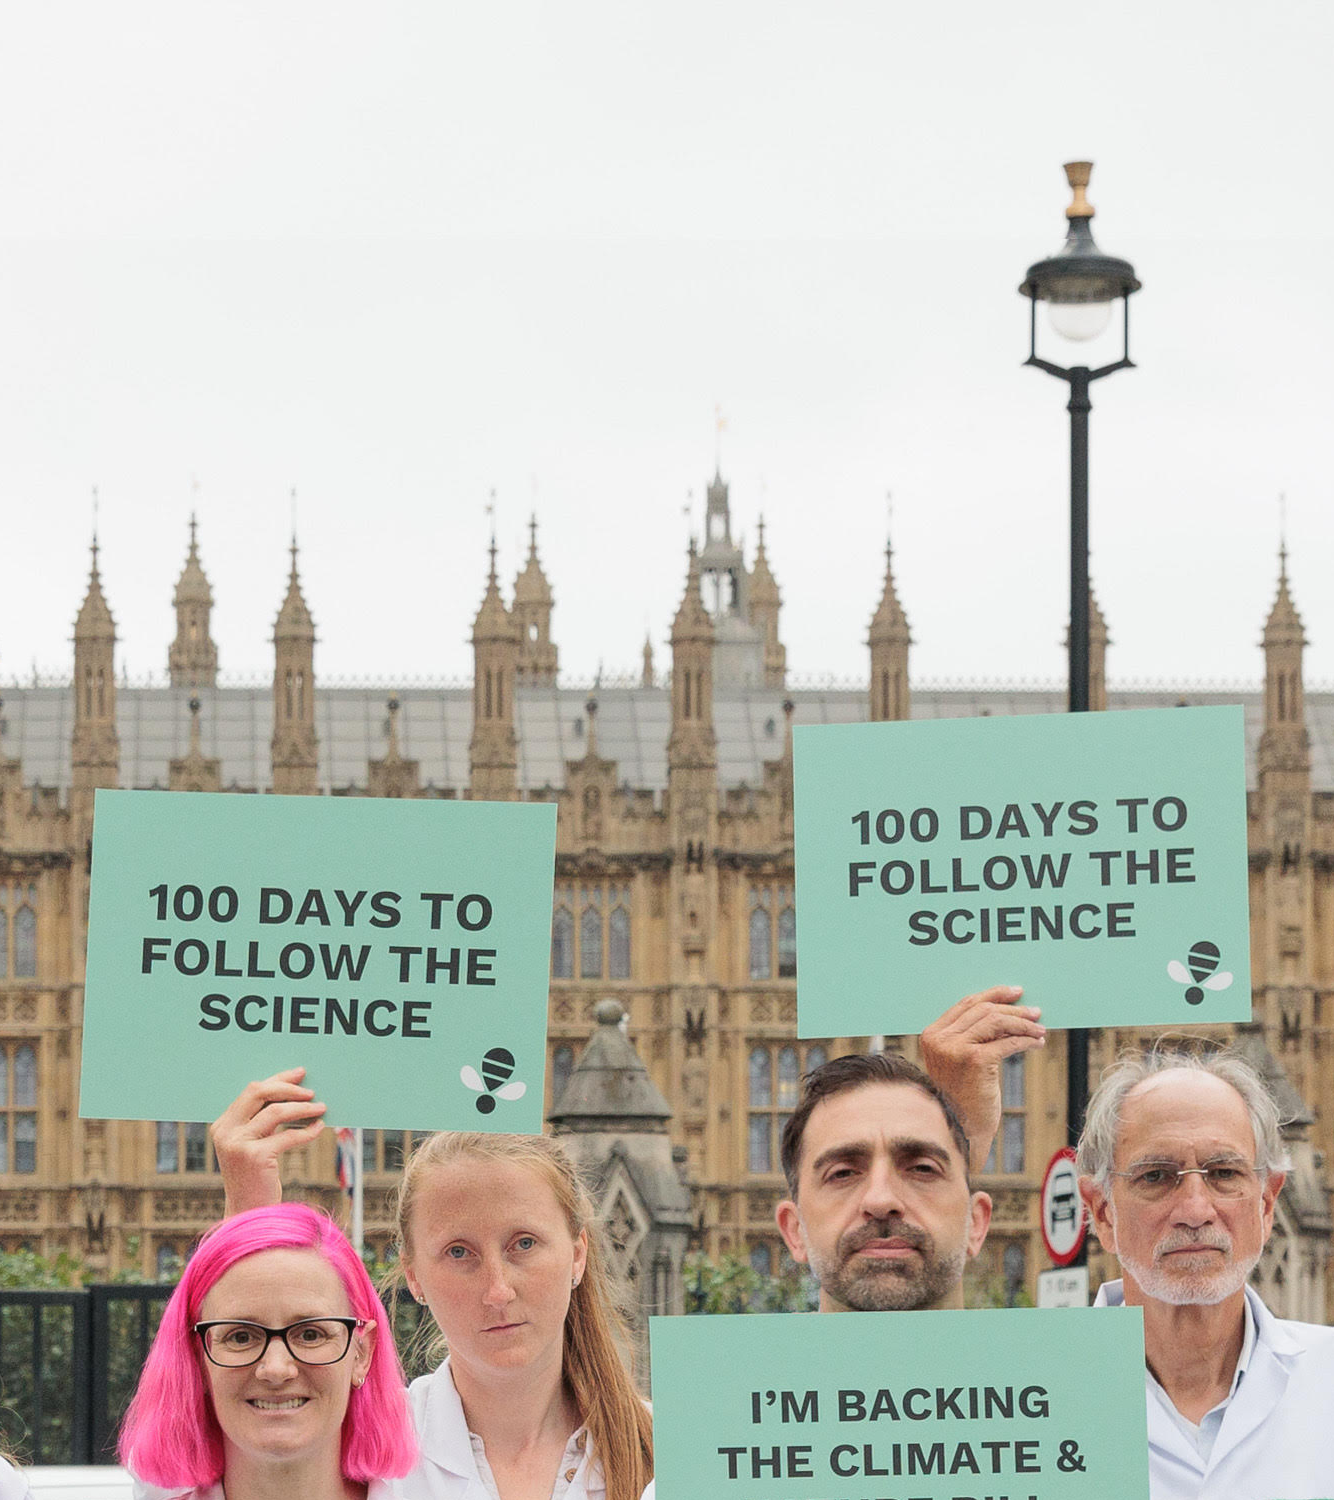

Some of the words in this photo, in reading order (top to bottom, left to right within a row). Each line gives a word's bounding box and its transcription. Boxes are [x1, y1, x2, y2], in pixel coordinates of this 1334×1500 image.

[852, 807, 939, 845] 100
[960, 802, 1098, 840] DAYS
[1116, 796, 1187, 833] TO
[849, 853, 1071, 897] FOLLOW
[1089, 847, 1196, 886] THE
[149, 884, 239, 923] 100
[259, 887, 401, 929] DAYS
[420, 892, 493, 932] TO
[908, 902, 1136, 946] SCIENCE
[141, 937, 371, 981] FOLLOW
[389, 946, 497, 986] THE
[199, 993, 432, 1038] SCIENCE
[751, 1390, 819, 1424] I'M
[838, 1385, 1049, 1422] BACKING
[717, 1445, 814, 1479] THE
[830, 1440, 1041, 1477] CLIMATE
[1056, 1439, 1086, 1473] &
